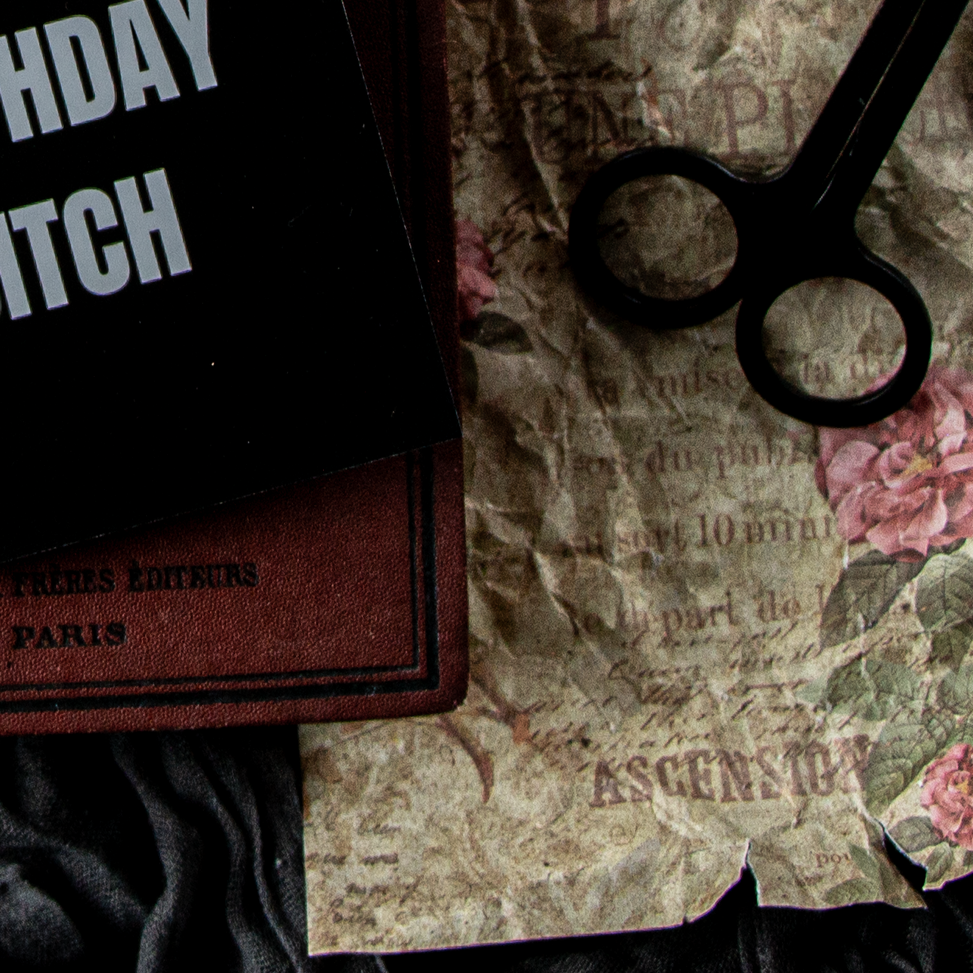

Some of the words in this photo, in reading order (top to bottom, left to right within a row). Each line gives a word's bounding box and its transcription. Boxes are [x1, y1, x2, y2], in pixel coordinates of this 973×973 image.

[697, 513, 738, 548] 10
[128, 560, 259, 593] ÉDITEURS
[12, 622, 126, 649] PARIS
